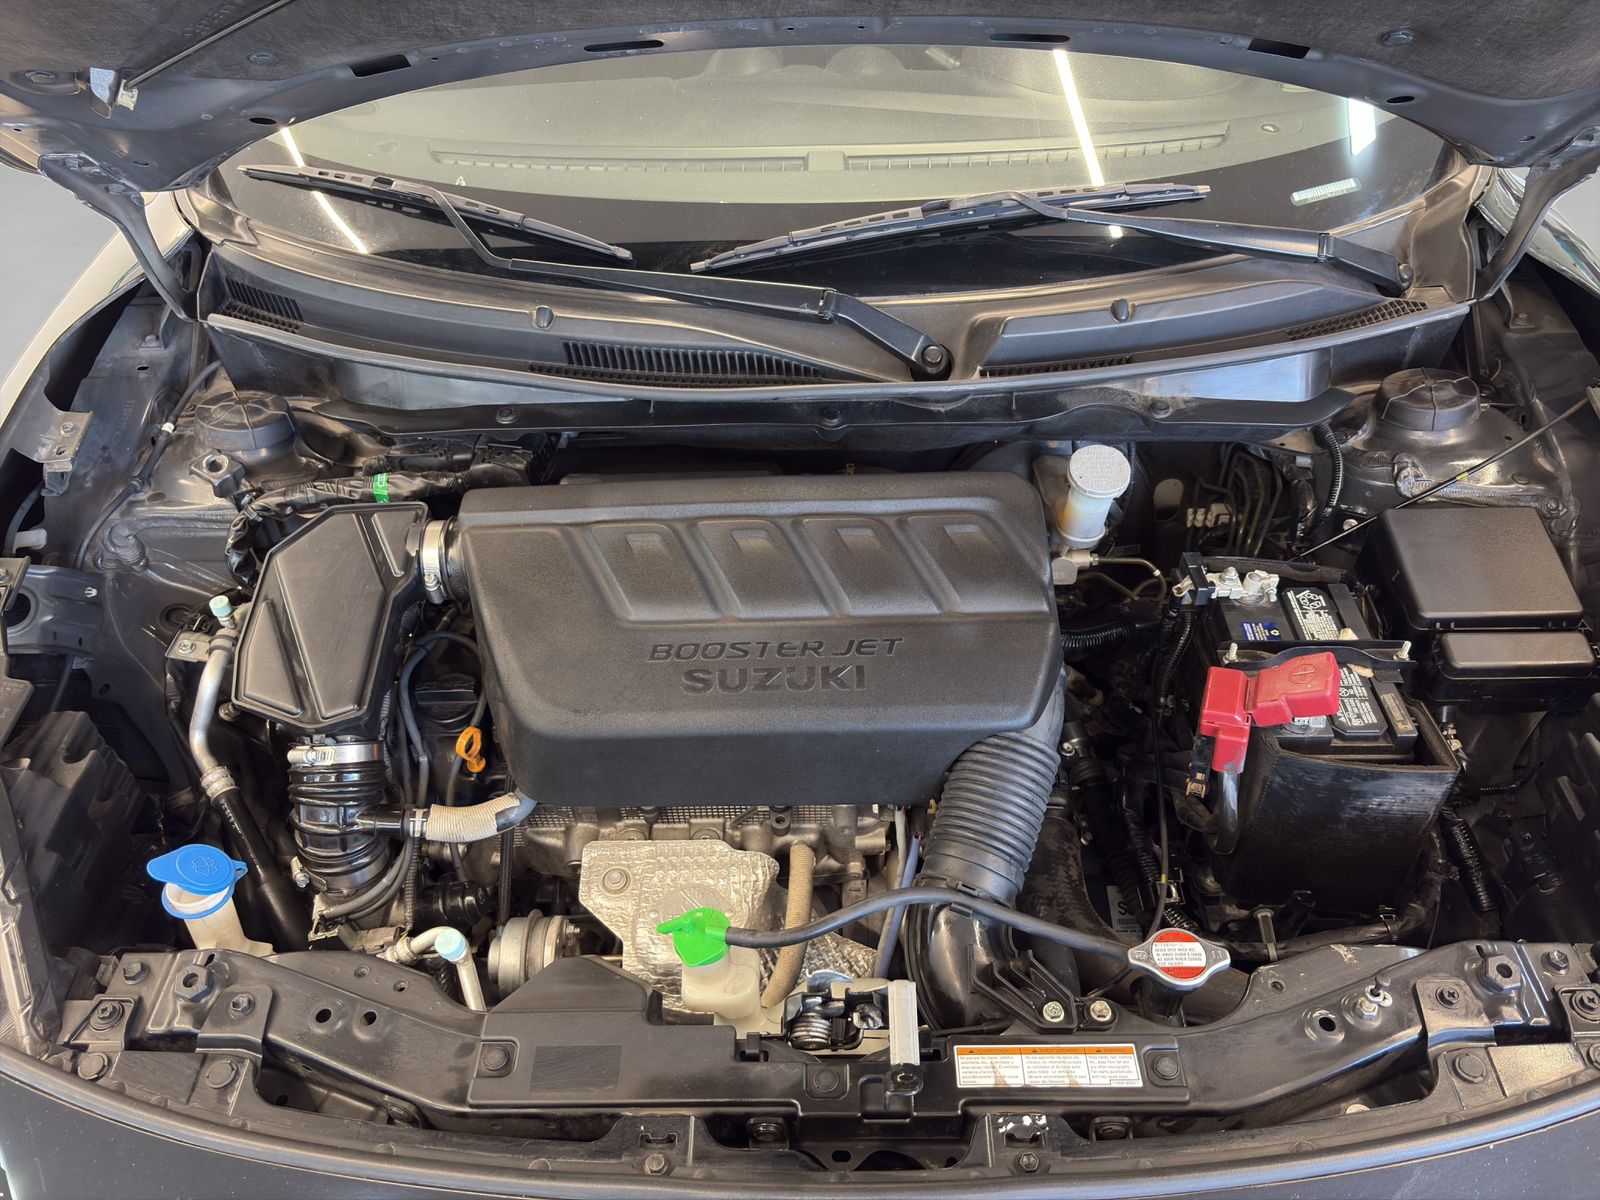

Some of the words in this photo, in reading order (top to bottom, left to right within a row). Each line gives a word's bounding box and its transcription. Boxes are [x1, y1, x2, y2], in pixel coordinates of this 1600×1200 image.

[648, 641, 824, 661] BOOSTER
[831, 638, 904, 657] JET
[681, 665, 866, 694] SUZUKI
